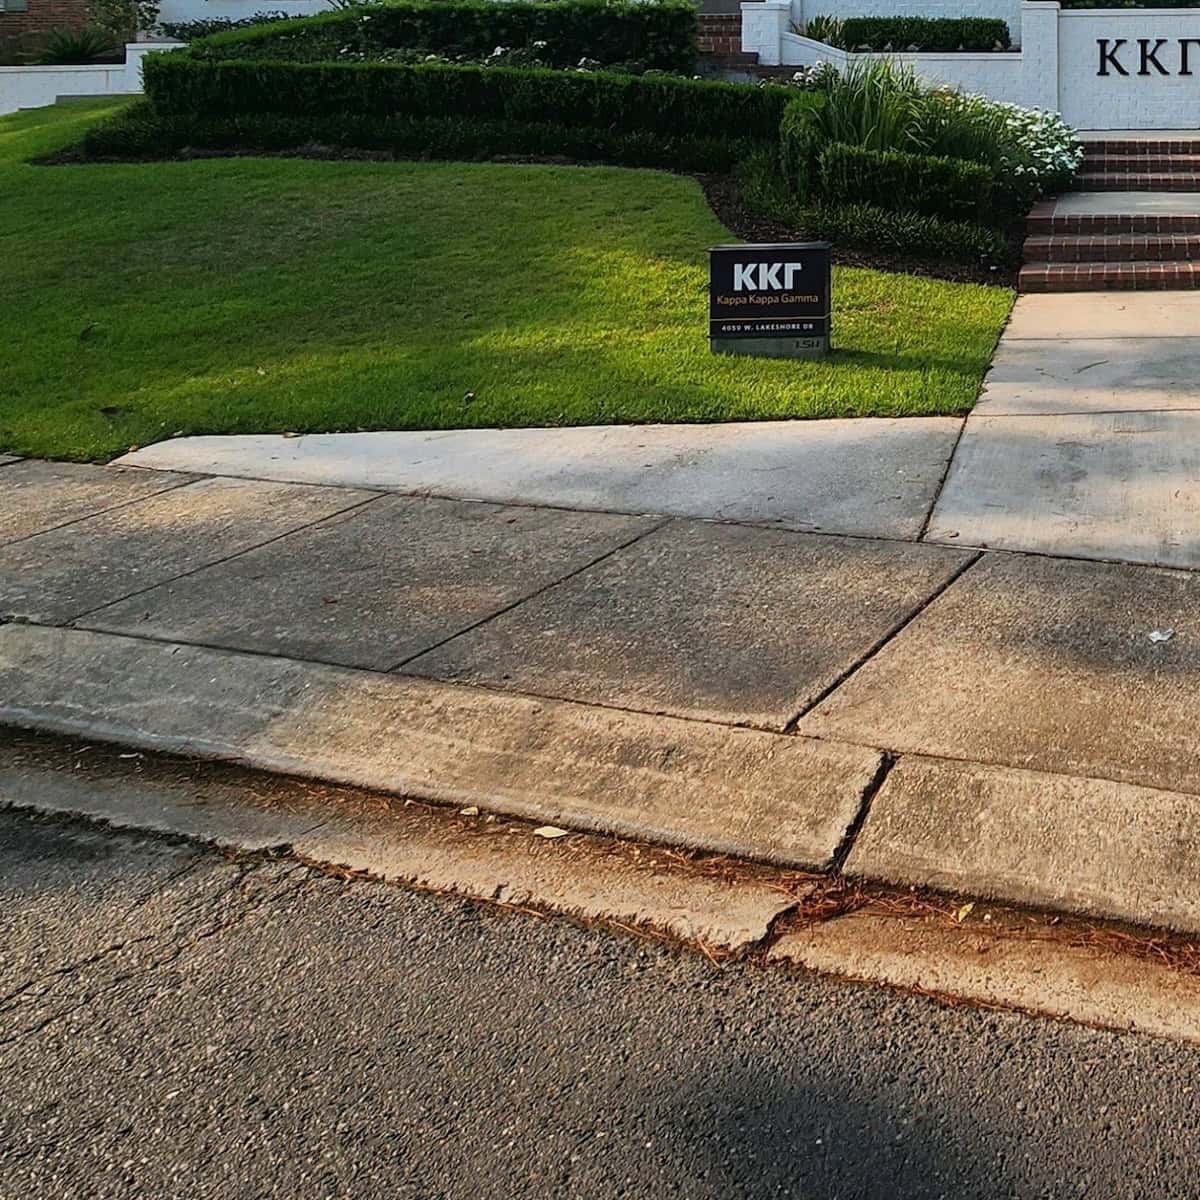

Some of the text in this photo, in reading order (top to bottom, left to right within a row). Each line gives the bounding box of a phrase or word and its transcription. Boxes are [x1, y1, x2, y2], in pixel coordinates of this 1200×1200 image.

[717, 294, 818, 306] Kappa Kappa Gamma
[755, 323, 801, 331] LAKESHORE
